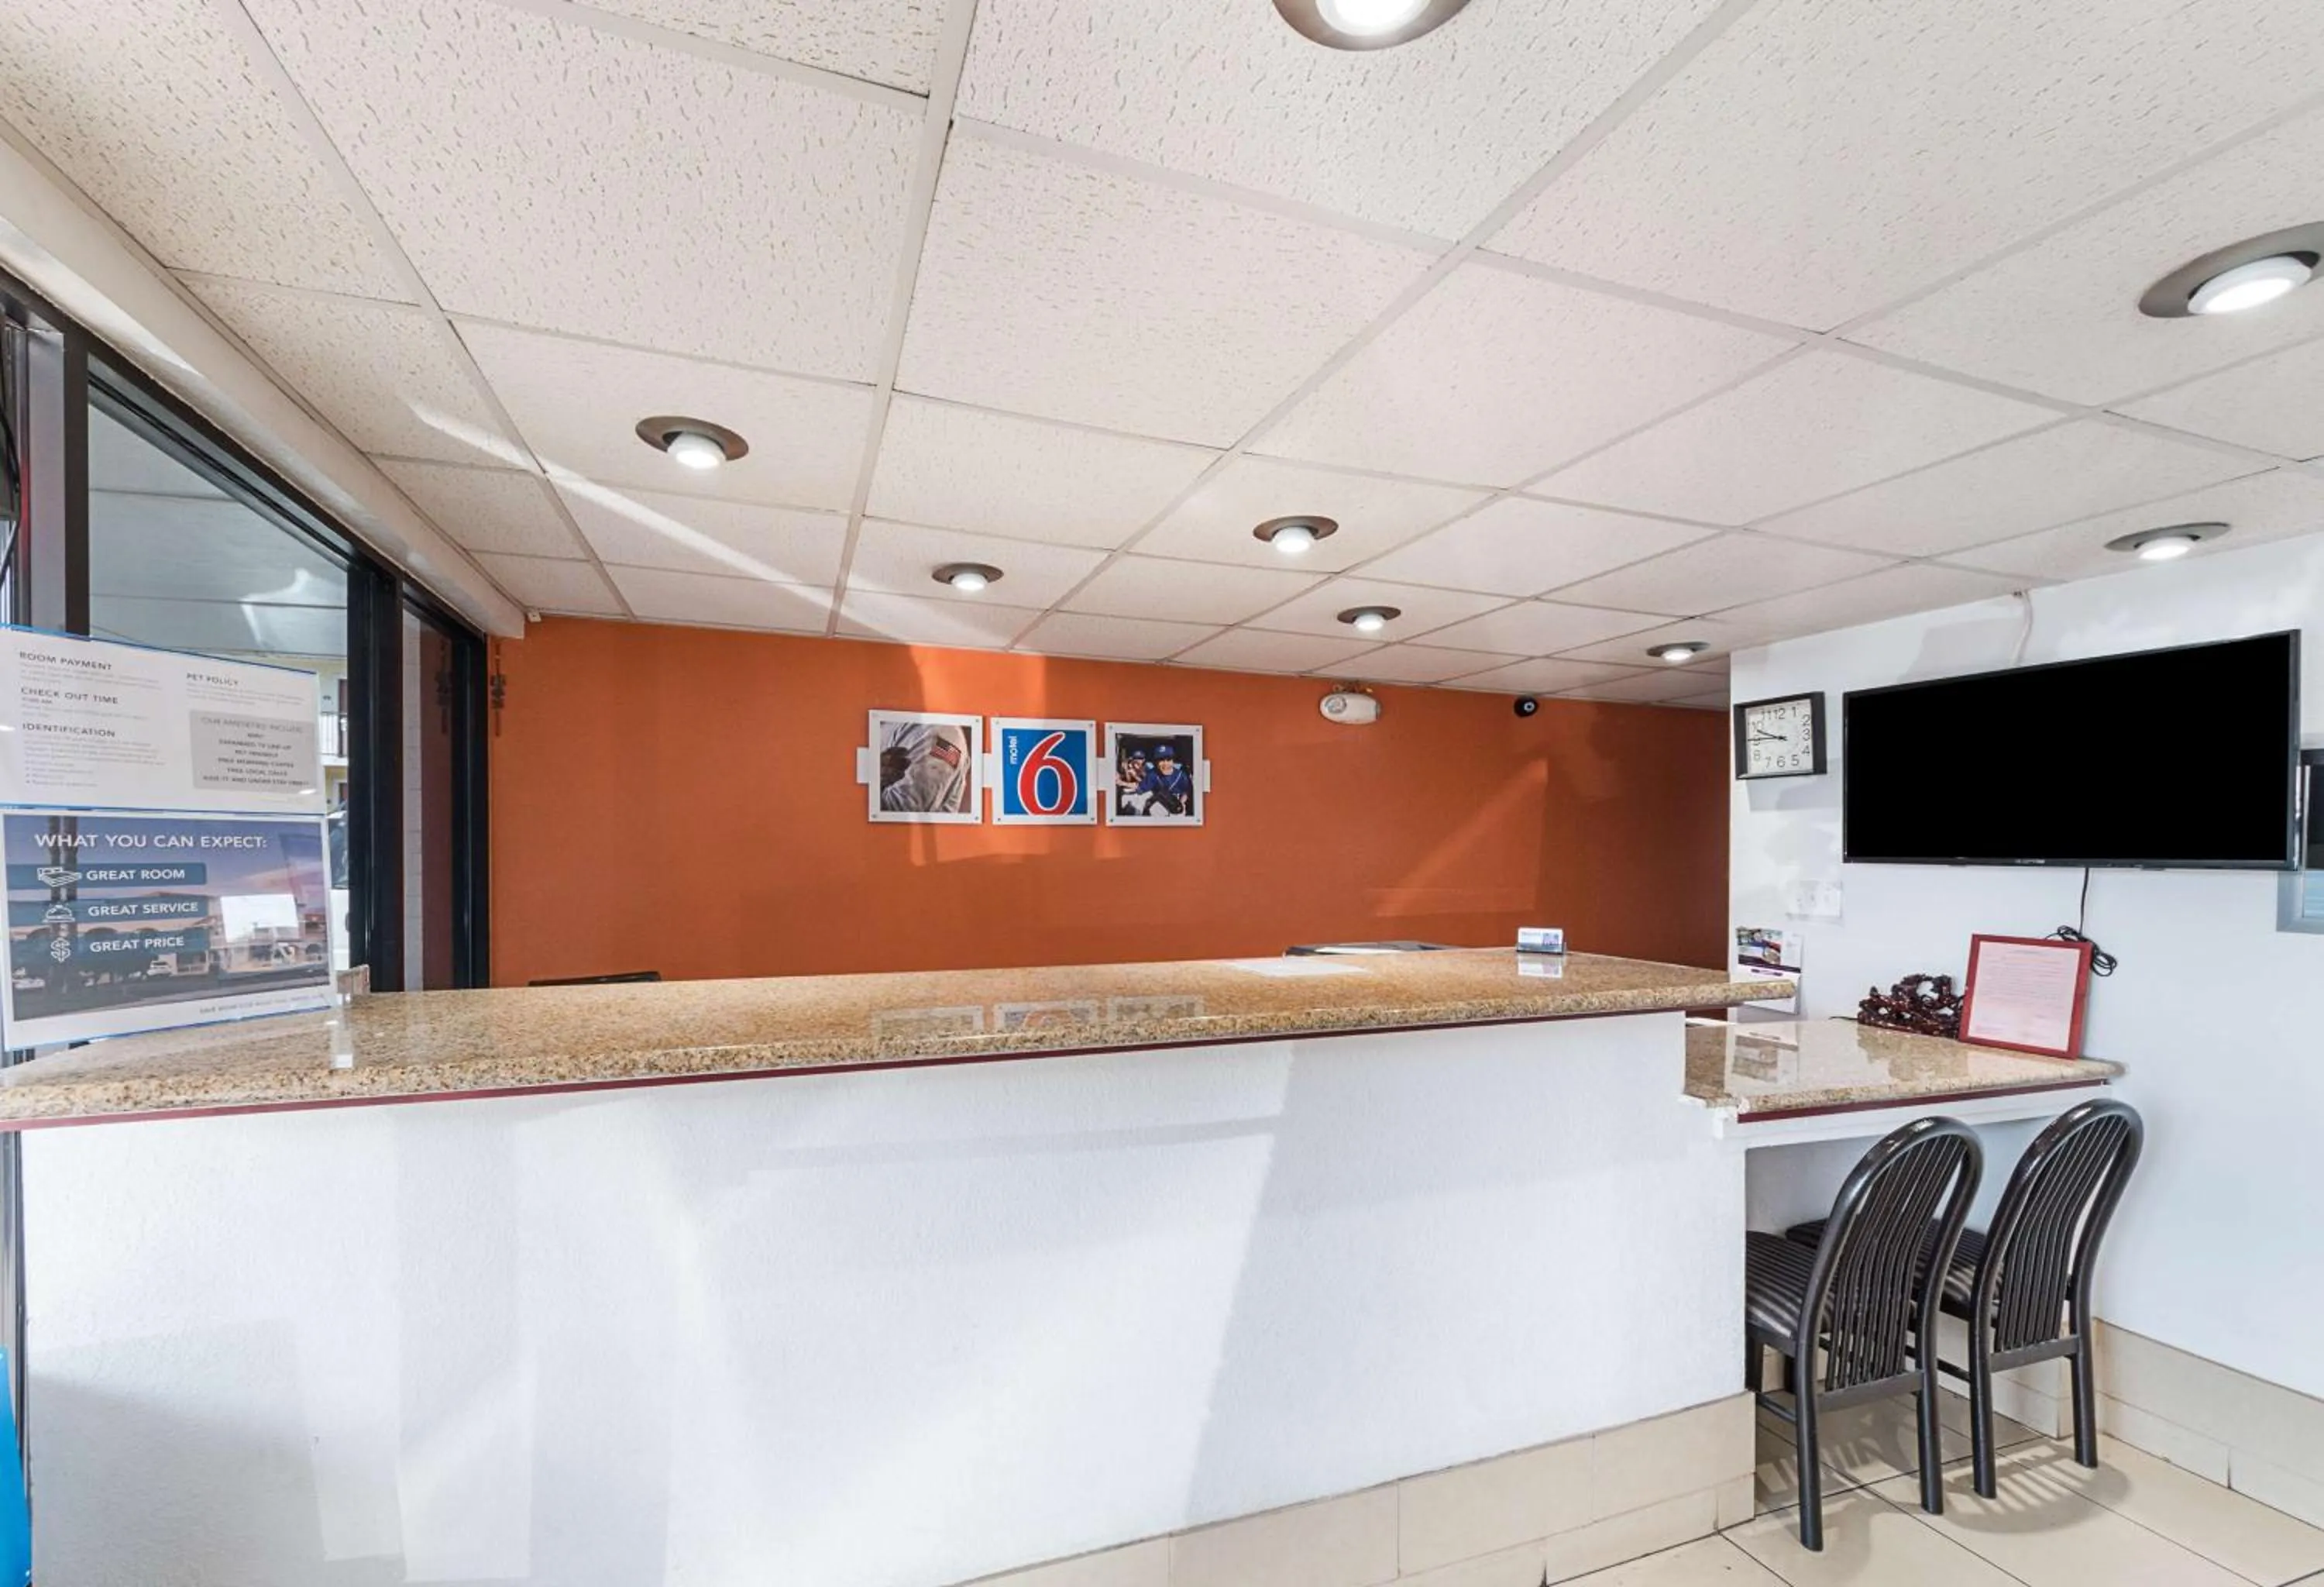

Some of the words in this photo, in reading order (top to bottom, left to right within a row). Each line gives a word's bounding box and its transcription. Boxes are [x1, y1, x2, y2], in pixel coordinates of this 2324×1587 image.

[19, 650, 56, 663] ROOM
[60, 658, 112, 670] PAYMENT
[187, 673, 203, 681] PET
[206, 675, 239, 687] POLICY
[21, 687, 60, 697] CHECK
[64, 692, 88, 701] OUT
[93, 695, 119, 704] TIME
[1762, 710, 1771, 720] 11
[1774, 707, 1786, 720] 12
[1792, 707, 1796, 718] 1
[1802, 714, 1810, 726] 2
[22, 722, 115, 738] IDENTIFICATION
[1803, 728, 1810, 741] 3
[1008, 735, 1018, 765] motel
[1754, 750, 1761, 761] 8
[1802, 745, 1810, 756] 4
[1765, 756, 1772, 769] 7
[1776, 756, 1786, 768] 6
[1790, 754, 1800, 766] 5
[1017, 732, 1078, 817] 6
[35, 834, 98, 849] WHAT
[105, 834, 146, 848] YOU
[154, 835, 194, 848] CAN
[201, 835, 267, 849] EXPECT:
[87, 869, 136, 881] GREAT
[141, 868, 185, 880] ROOM
[88, 904, 138, 917] GREAT
[143, 902, 198, 914] SERVICE
[90, 939, 140, 952] GREAT
[144, 935, 184, 948] PRICE
